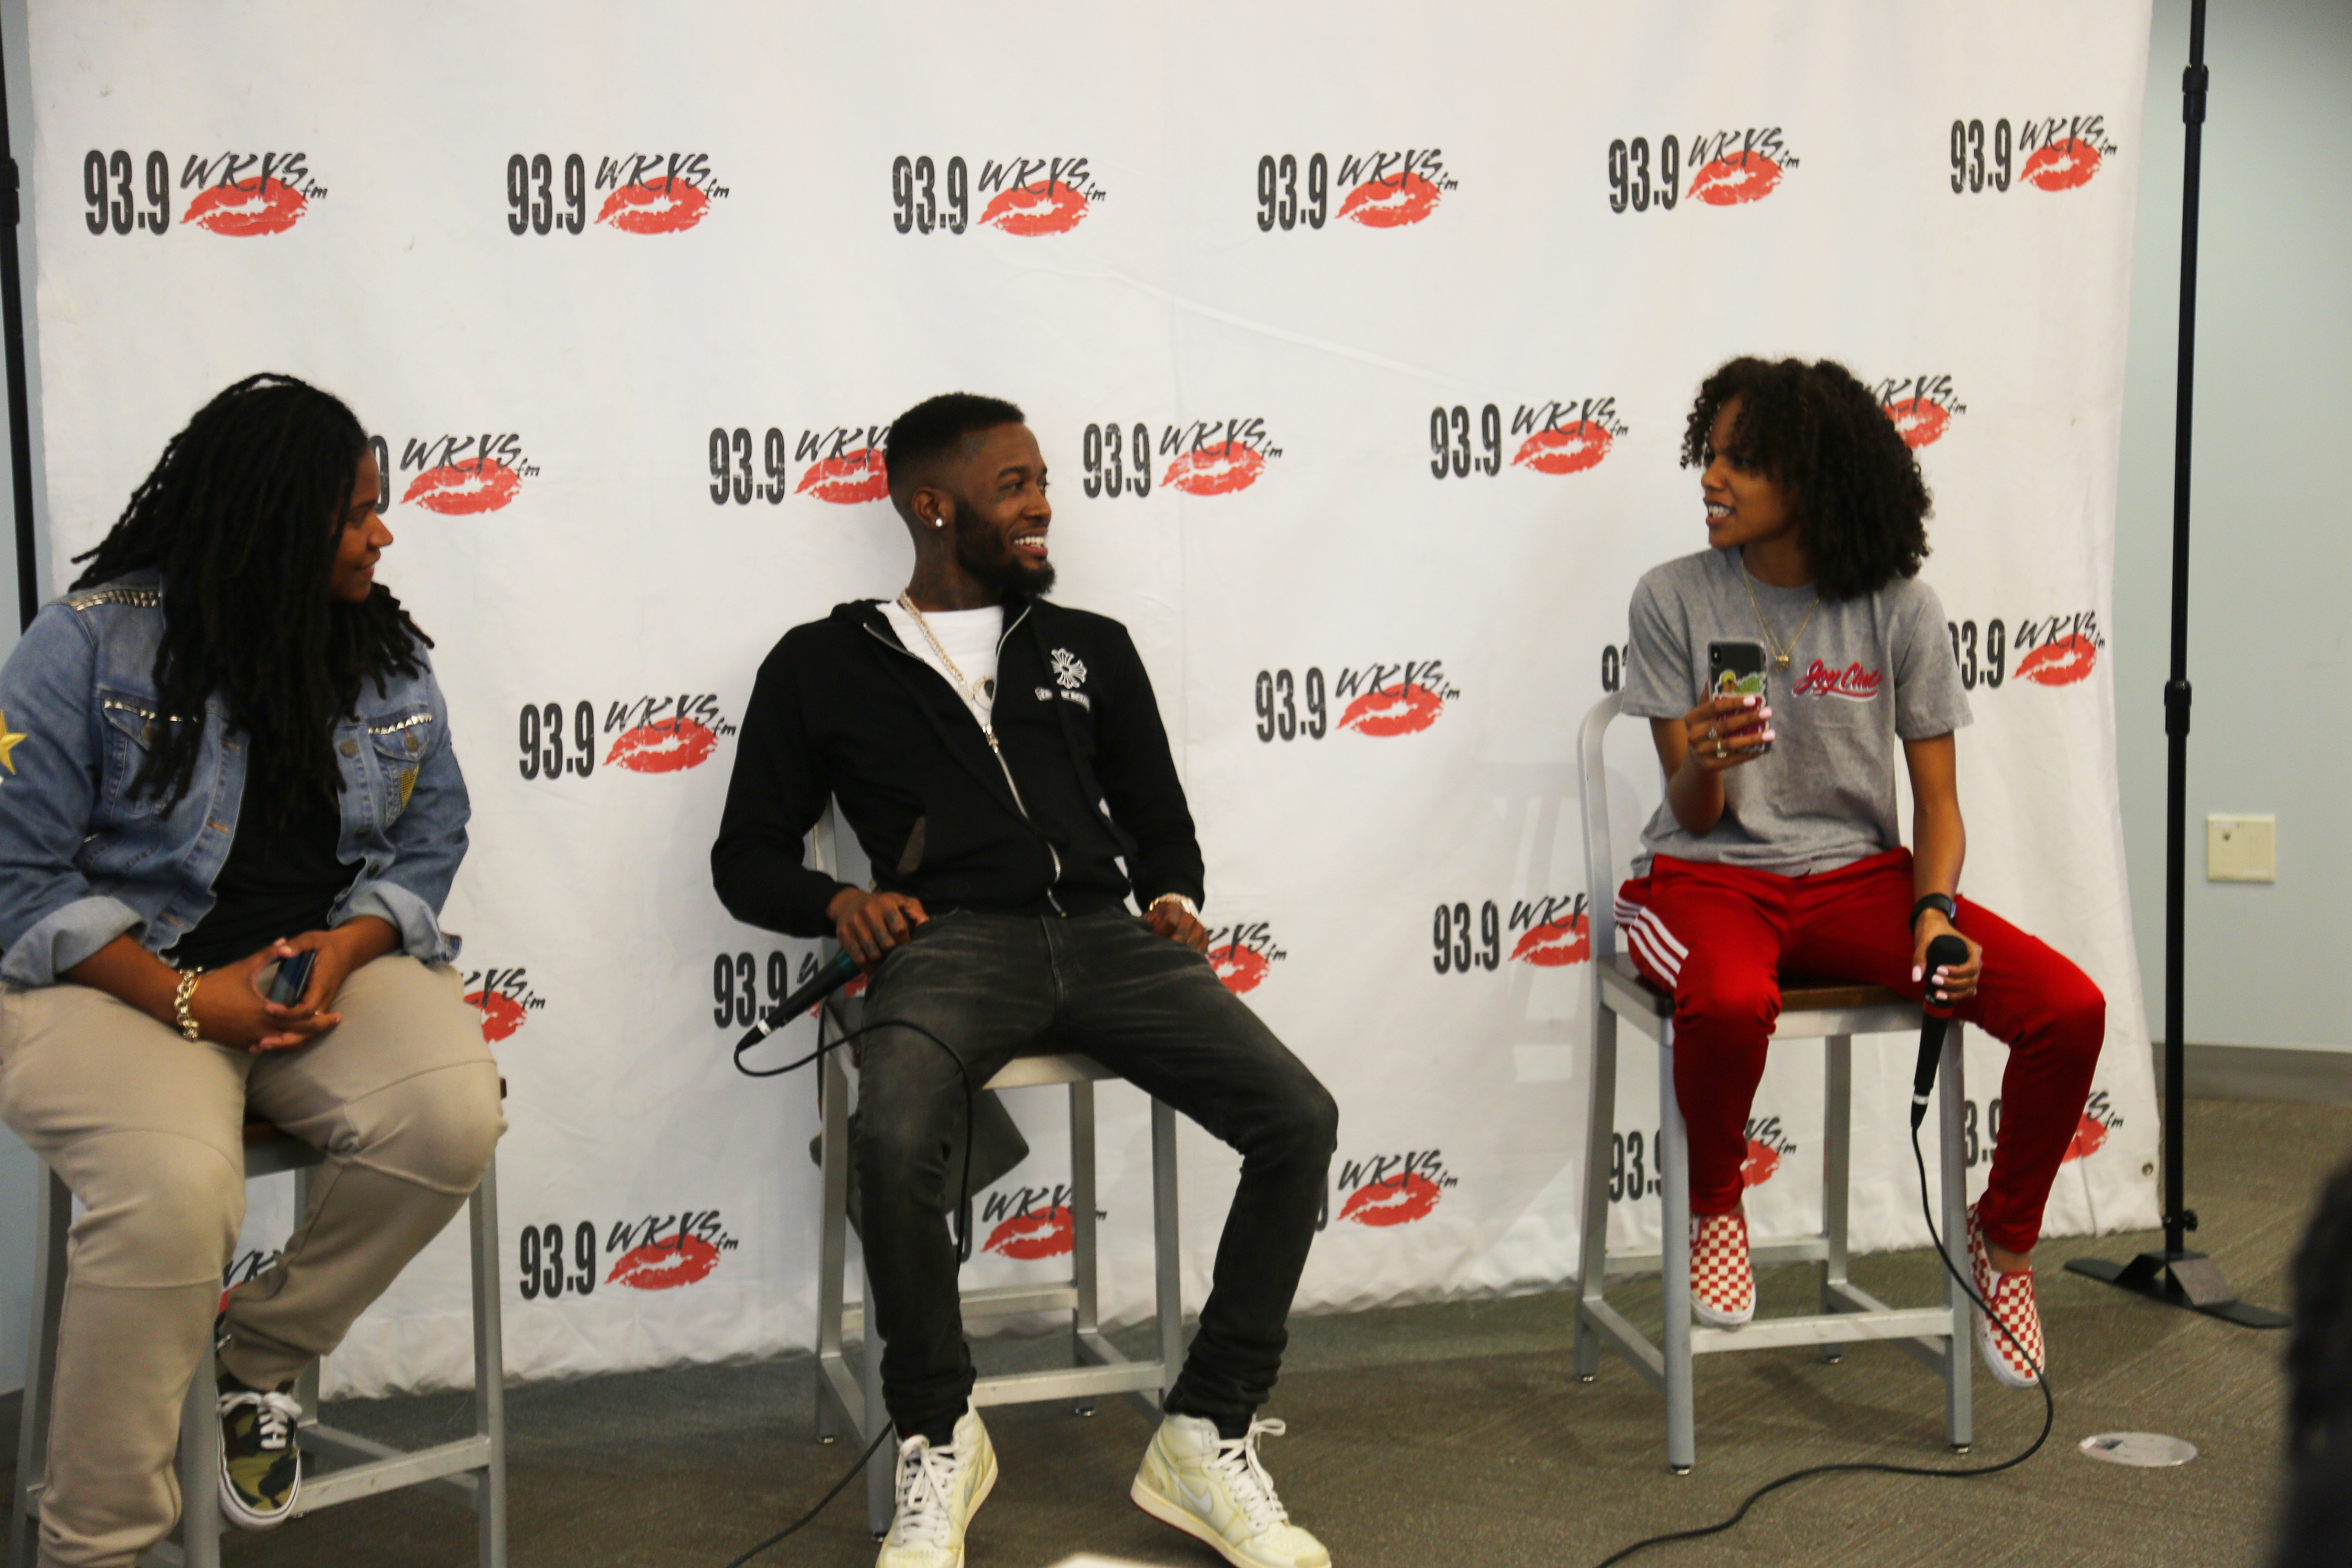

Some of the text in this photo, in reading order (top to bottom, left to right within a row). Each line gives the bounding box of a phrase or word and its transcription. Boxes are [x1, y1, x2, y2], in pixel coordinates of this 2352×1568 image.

[84, 150, 170, 236] 93.9
[180, 151, 309, 195] WKYS
[507, 154, 586, 236] 93.9
[595, 153, 711, 195] WKYS
[892, 155, 968, 235] 93.9
[978, 157, 1090, 197] WKYS
[1257, 153, 1327, 232] 93.9
[1337, 149, 1443, 188] WKYS
[1608, 134, 1679, 214] 93.9
[1688, 127, 1783, 167] WKYS
[1951, 118, 2011, 194] 93.9
[2019, 115, 2105, 154] WKYS
[1875, 374, 1953, 413] KYS
[400, 434, 522, 474] WKYS
[709, 426, 891, 505] 93.9 WKY
[1083, 423, 1151, 499] 93.9
[1159, 418, 1266, 457] WKYS
[1430, 403, 1501, 480] 93.9
[1511, 397, 1615, 436] WKYS
[2014, 610, 2096, 650] WKYS
[519, 700, 595, 780] 93.9
[604, 694, 719, 734] WKYS
[1255, 667, 1327, 743] 93.9
[1336, 660, 1443, 699] WKYS
[1433, 893, 1589, 975] 93.9 WKY
[713, 950, 787, 1029] 93.9
[982, 1183, 1072, 1223] WKY
[1338, 1148, 1443, 1191] WKYS
[519, 1220, 596, 1301] 93.9
[606, 1209, 722, 1252] WKYS
